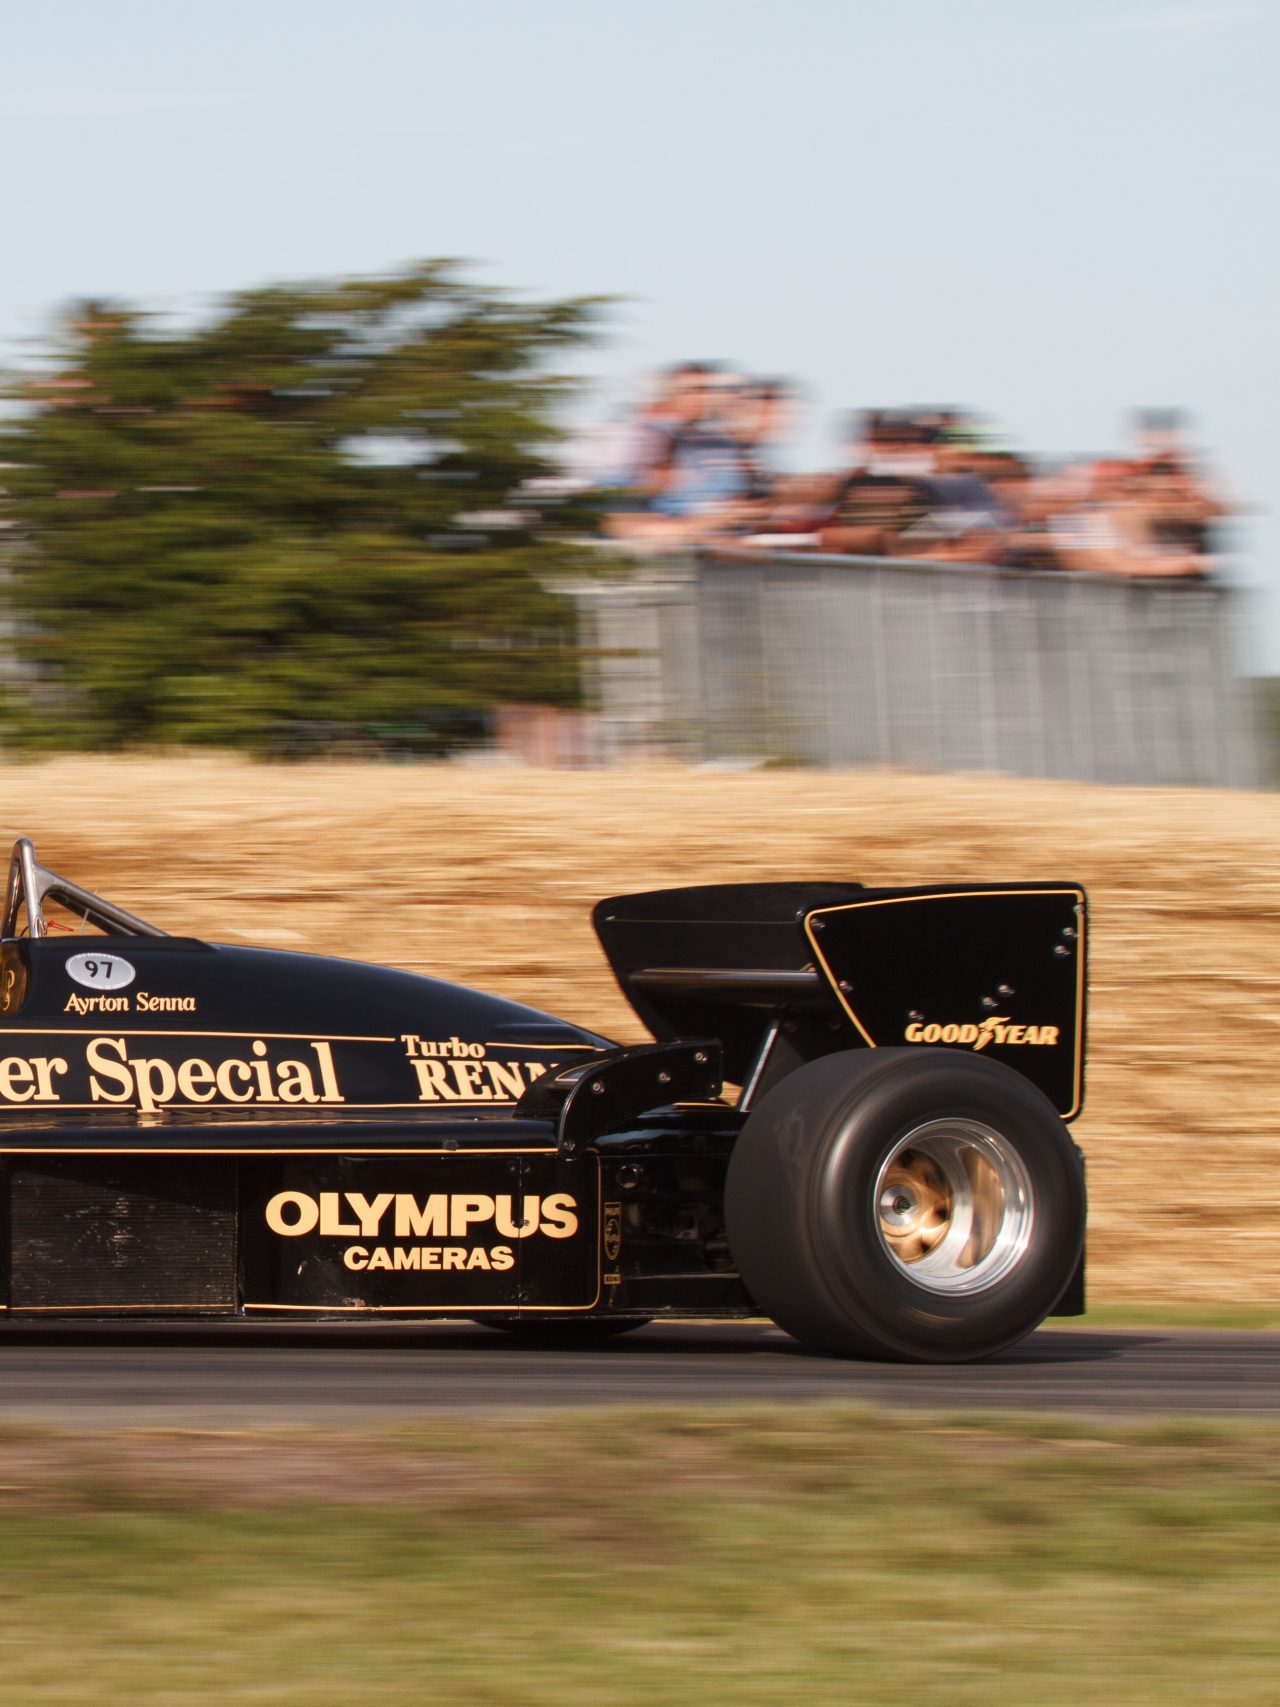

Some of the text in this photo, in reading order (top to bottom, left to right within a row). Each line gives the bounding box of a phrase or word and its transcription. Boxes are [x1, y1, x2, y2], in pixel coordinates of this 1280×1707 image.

[84, 960, 113, 979] 97
[63, 991, 196, 1016] Ayrton Senna
[400, 1034, 486, 1059] Turbo
[904, 1016, 1060, 1051] GOODYEAR
[85, 1037, 345, 1113] Special
[265, 1190, 579, 1239] OLYMPUS
[343, 1245, 515, 1271] CAMERAS
